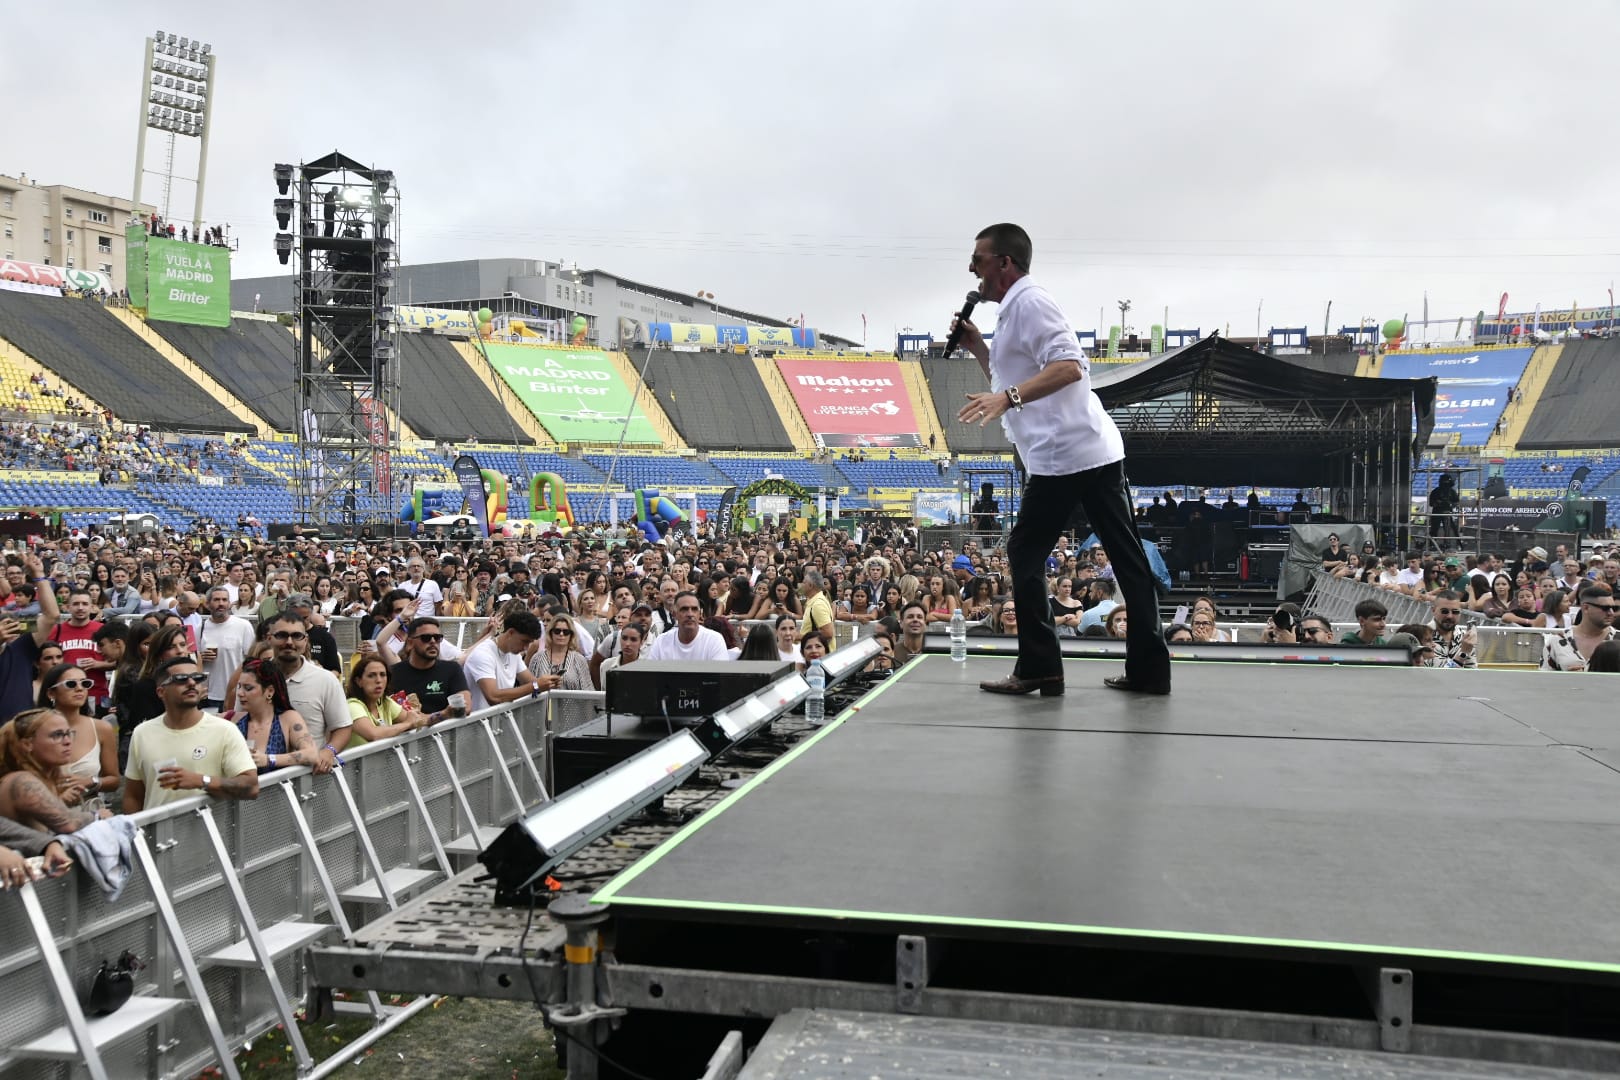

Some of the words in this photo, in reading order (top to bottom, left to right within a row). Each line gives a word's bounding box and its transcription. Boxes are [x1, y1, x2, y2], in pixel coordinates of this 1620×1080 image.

[166, 254, 201, 270] VUELA
[204, 261, 212, 271] A
[166, 268, 214, 283] MADRID
[169, 288, 209, 304] Binter
[1581, 310, 1612, 320] LIVE
[544, 358, 563, 369] A
[505, 365, 611, 381] MADRID
[796, 375, 894, 387] Mahou
[529, 381, 610, 396] Binter
[1436, 398, 1496, 409] OLSEN
[1473, 506, 1494, 514] AONO
[678, 698, 700, 709] LP11
